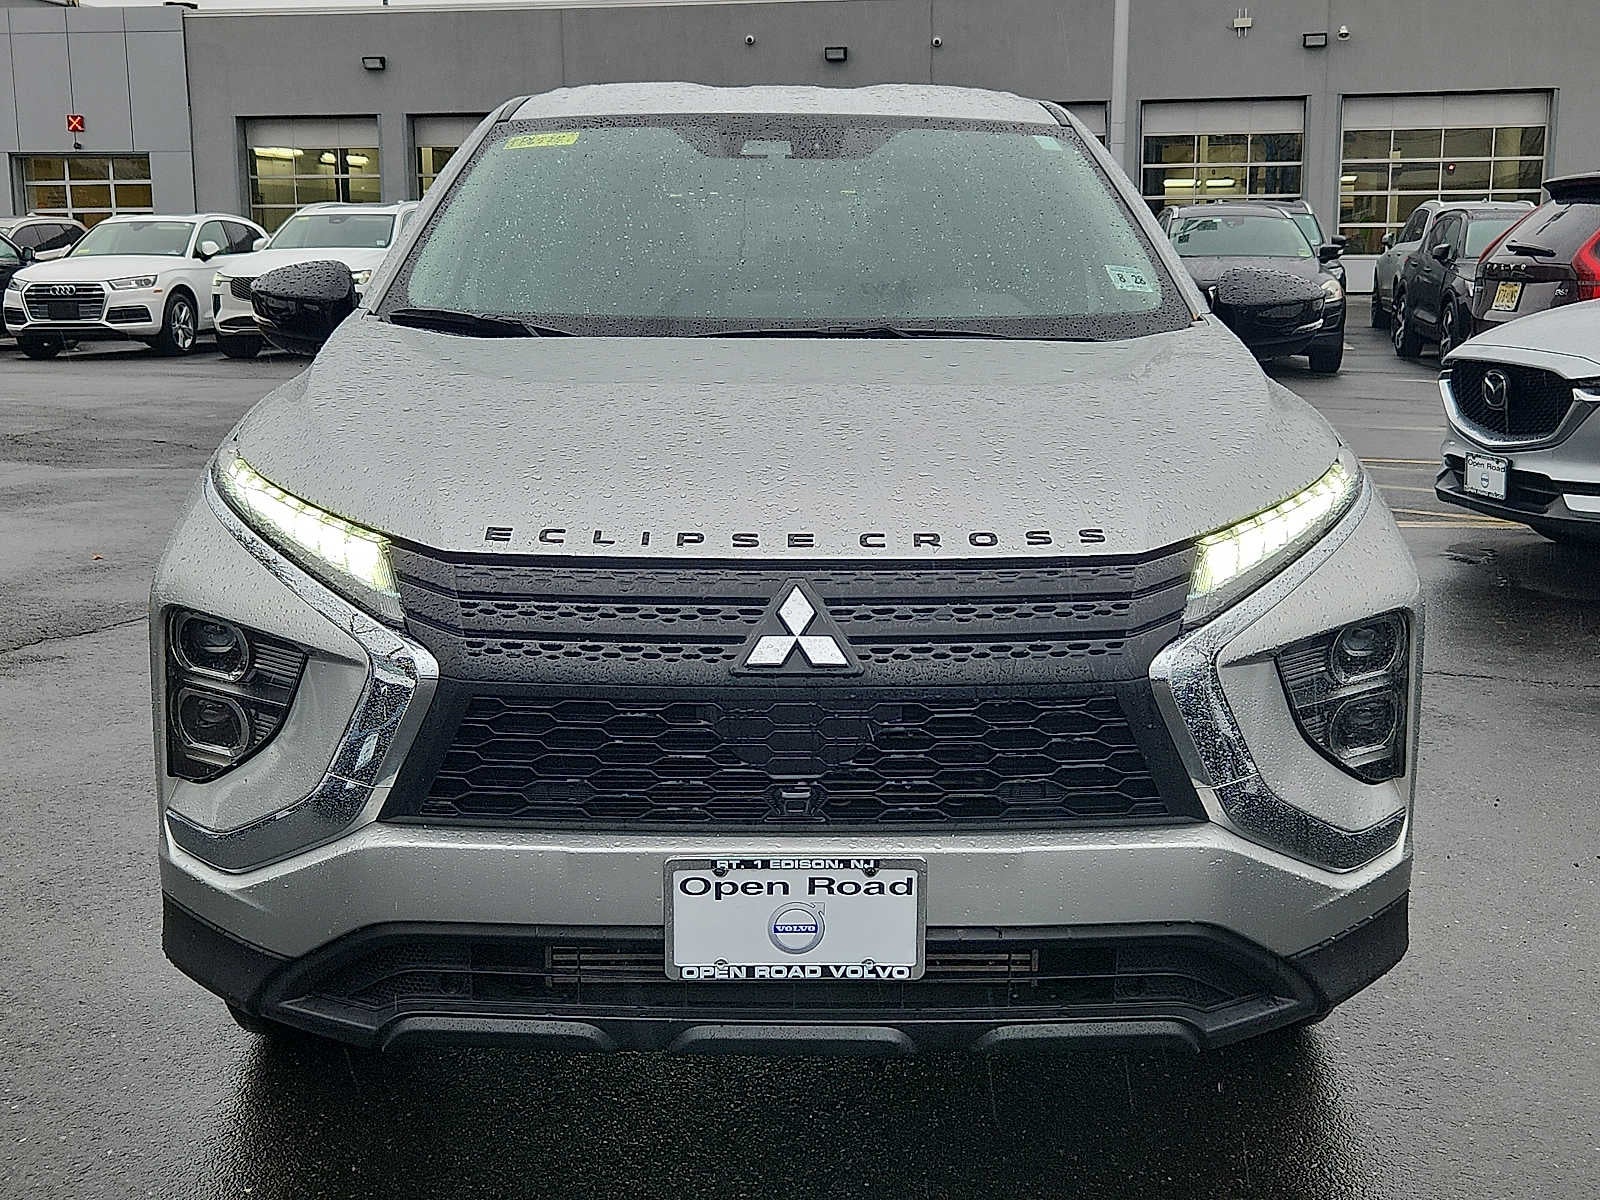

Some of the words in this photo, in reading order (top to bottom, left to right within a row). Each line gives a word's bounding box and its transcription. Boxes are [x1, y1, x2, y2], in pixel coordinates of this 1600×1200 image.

[484, 526, 814, 548] ECLIPSE
[859, 528, 1106, 548] CROSS
[850, 859, 875, 869] NJ
[679, 876, 790, 901] Open
[807, 876, 914, 896] Road
[775, 924, 816, 933] VOLVO
[681, 966, 749, 979] OPEN
[755, 966, 822, 979] ROAD
[829, 966, 911, 979] VOLVO
